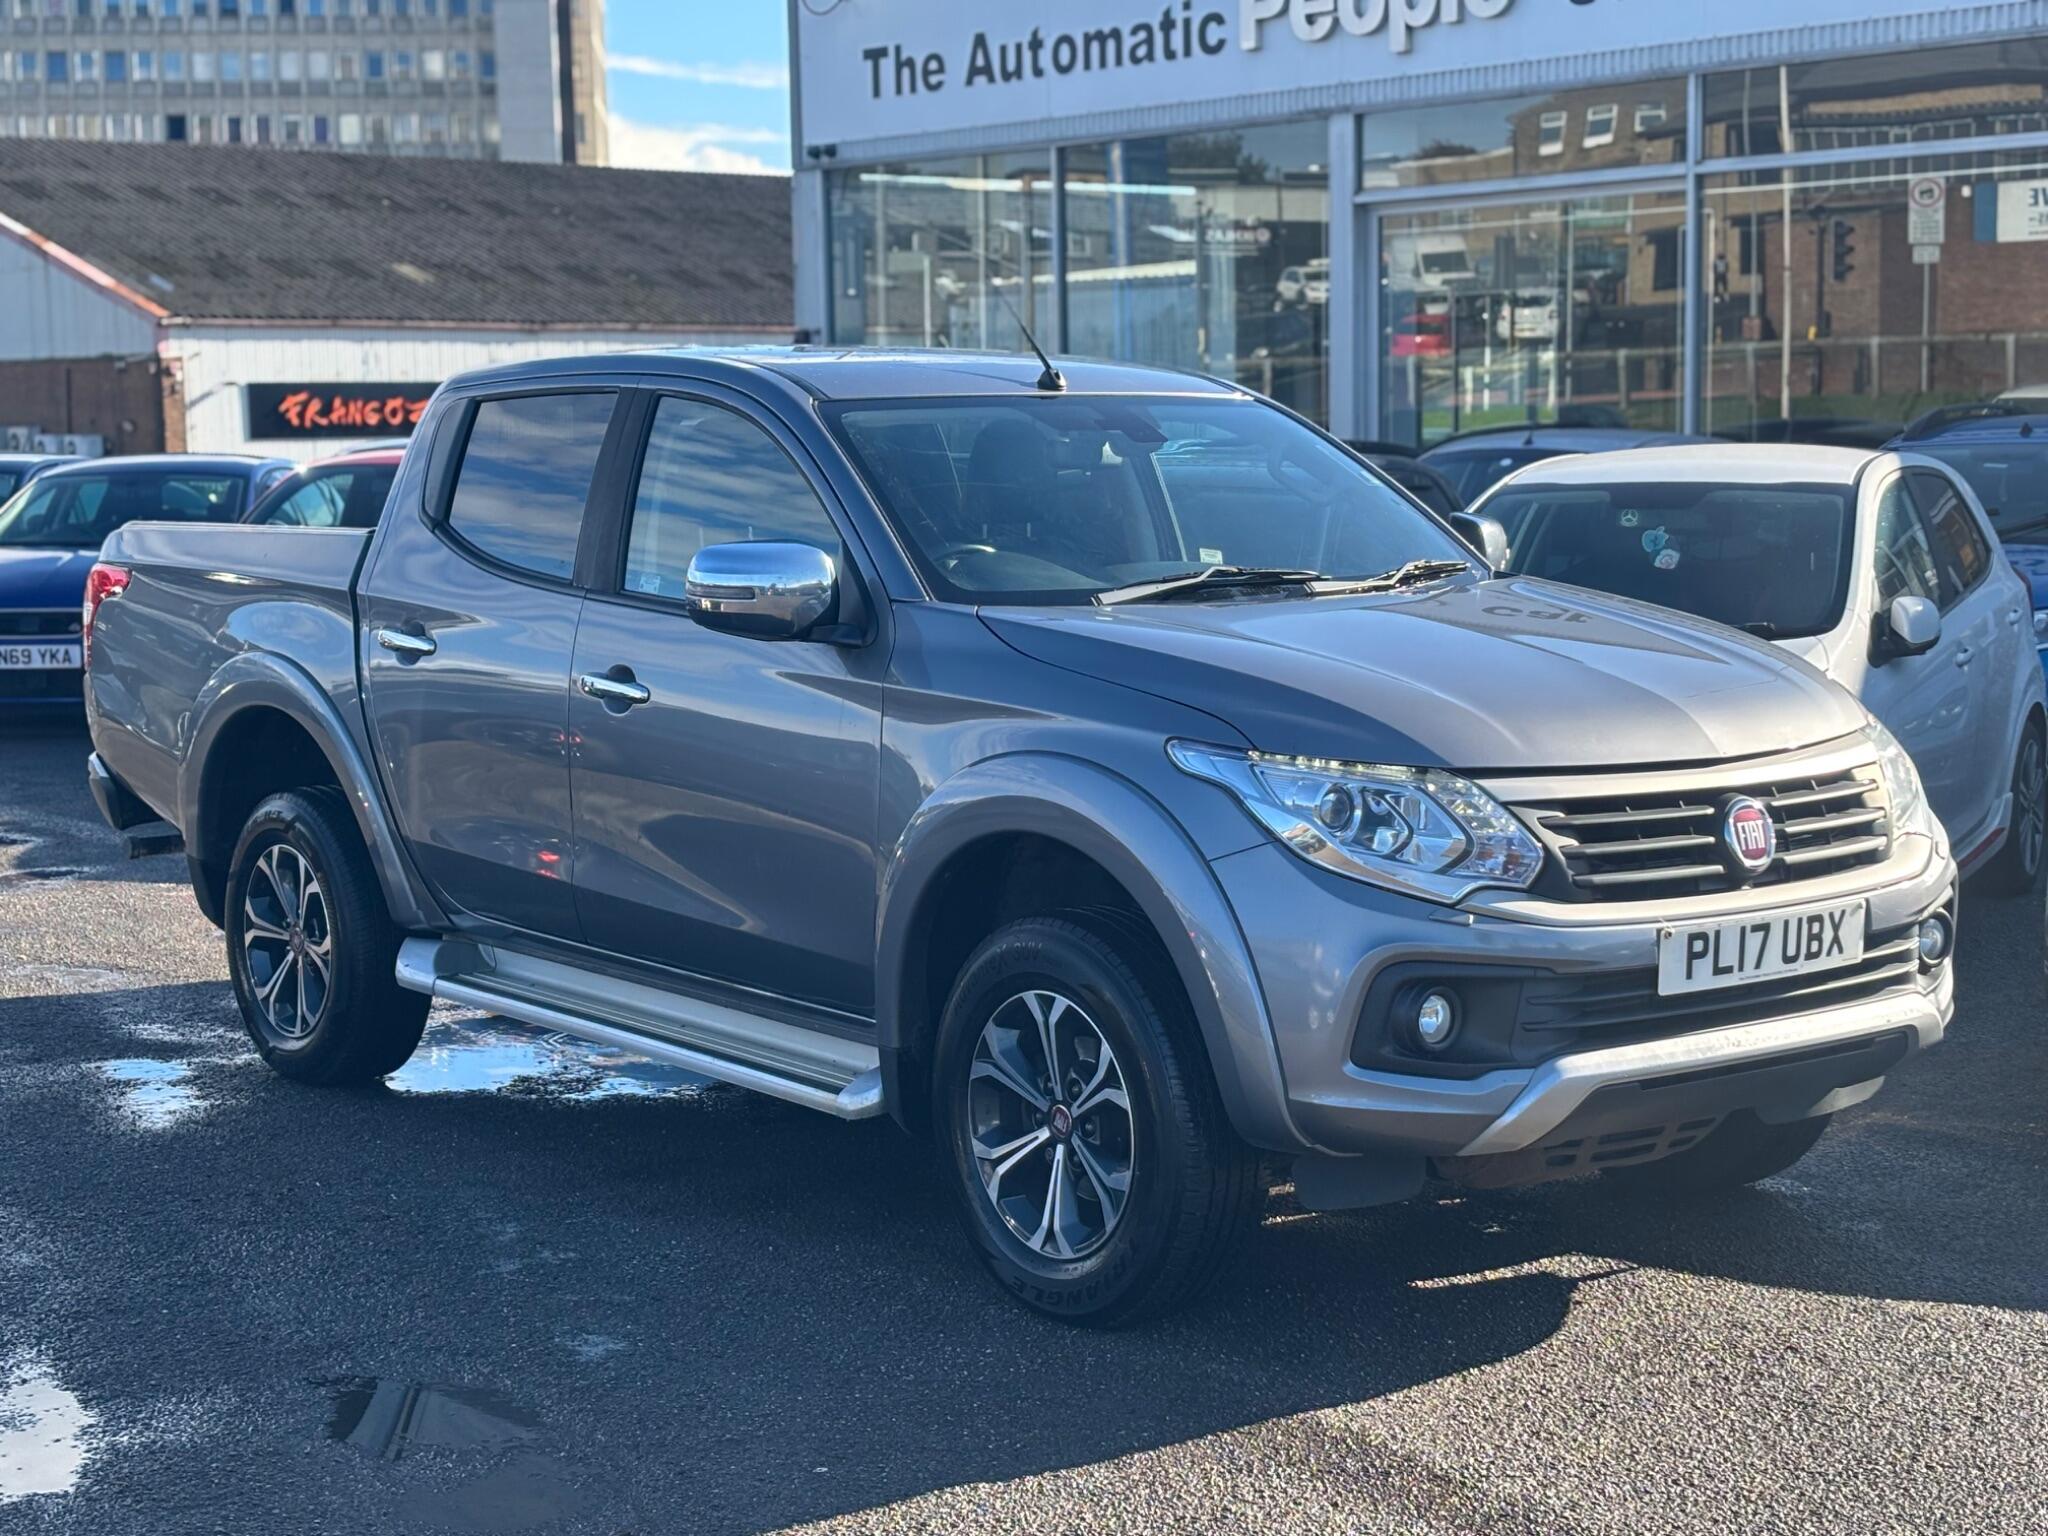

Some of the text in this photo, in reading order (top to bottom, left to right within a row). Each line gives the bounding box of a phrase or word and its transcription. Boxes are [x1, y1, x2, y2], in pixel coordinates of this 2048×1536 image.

[863, 45, 945, 99] The
[965, 0, 1227, 86] Automatic
[37, 648, 73, 665] YKA
[1736, 819, 1766, 850] FIAT
[1781, 908, 1847, 966] UBX
